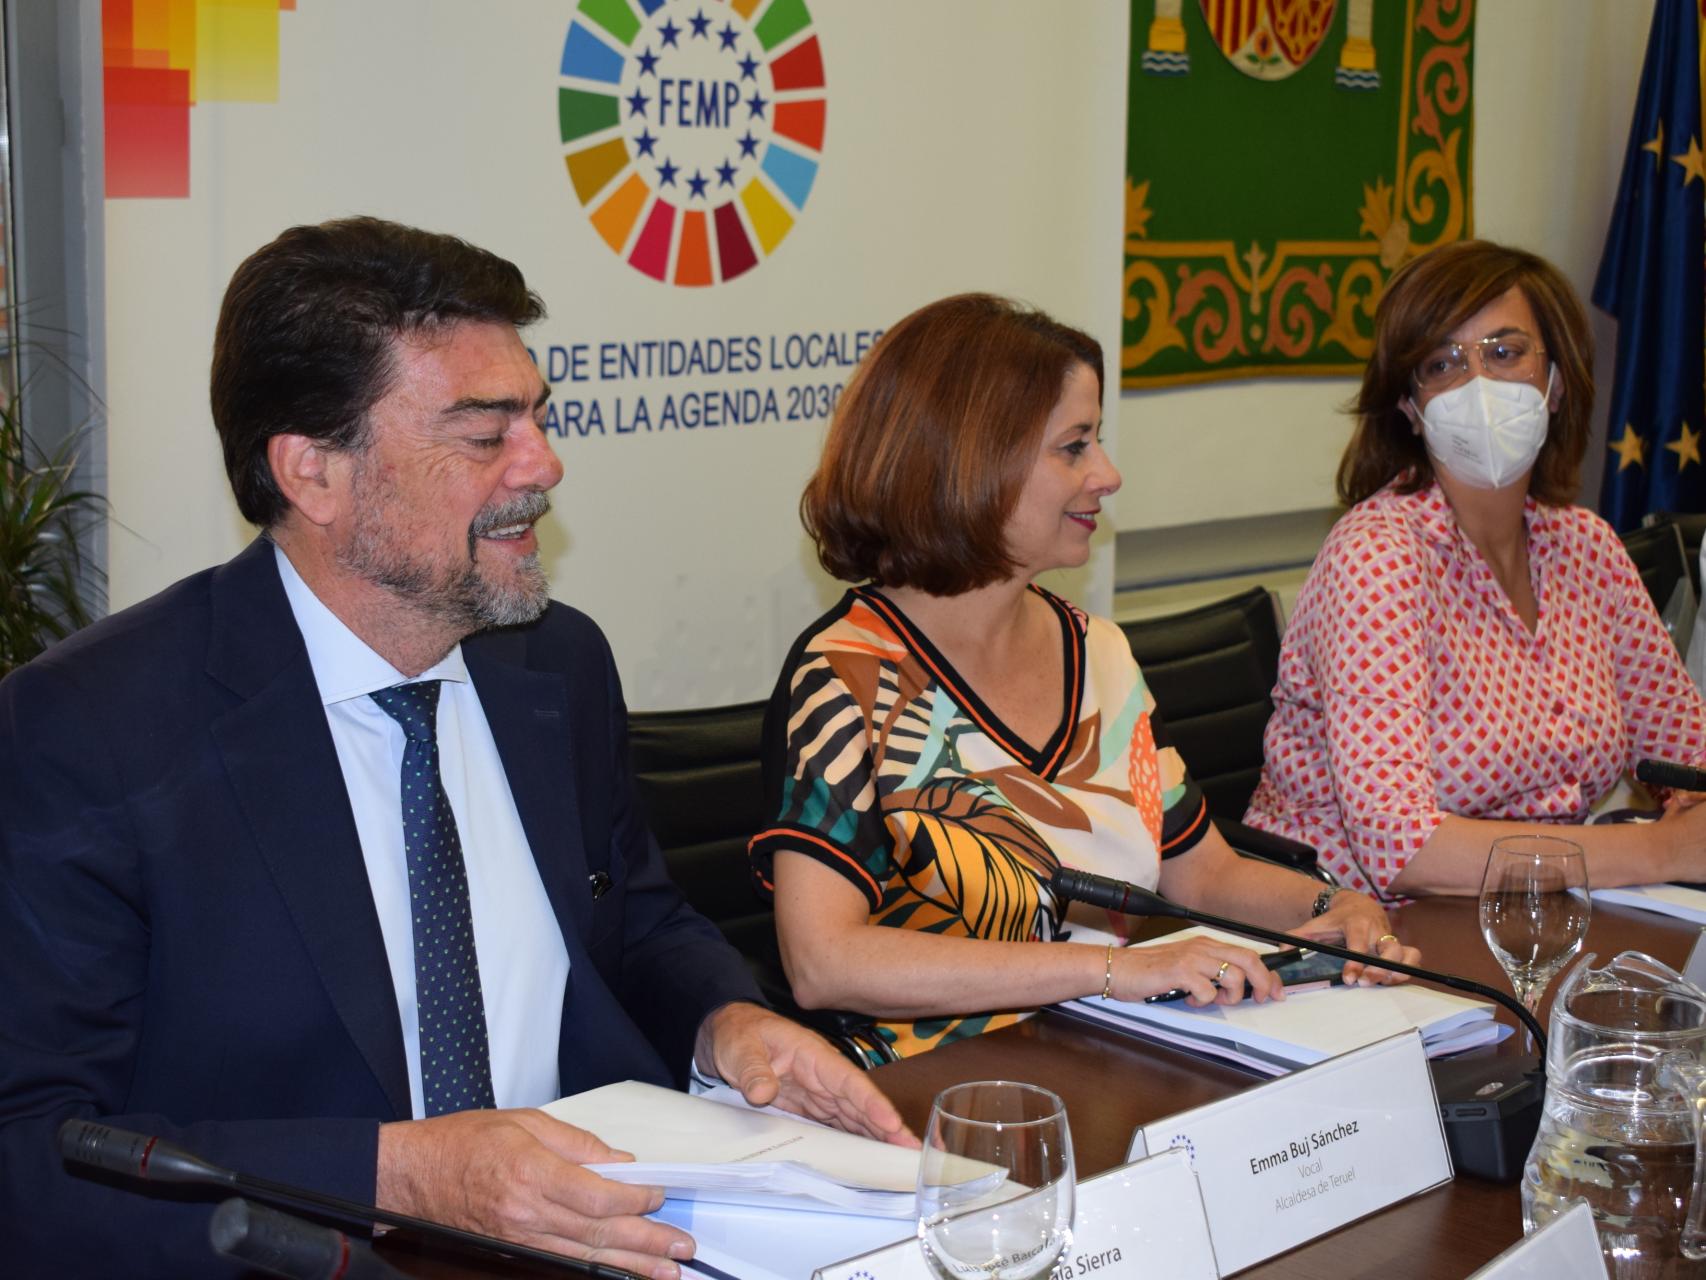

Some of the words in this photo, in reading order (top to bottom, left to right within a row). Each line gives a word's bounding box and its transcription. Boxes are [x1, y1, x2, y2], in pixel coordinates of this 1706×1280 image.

[659, 79, 740, 128] FEMP
[548, 345, 590, 382] DE
[600, 336, 762, 379] ENTIDADES
[545, 399, 606, 438] ARA
[616, 396, 652, 433] LA
[659, 387, 780, 431] AGENDA
[1250, 1150, 1288, 1175] Emma
[1289, 1136, 1311, 1158] Buj
[1311, 1120, 1359, 1150] Sánchez
[1298, 1157, 1324, 1178] Vocal
[1275, 1186, 1317, 1212] Alcaldesa
[1317, 1180, 1329, 1194] de
[1329, 1166, 1357, 1189] Teruel
[1075, 1247, 1122, 1275] Sierra
